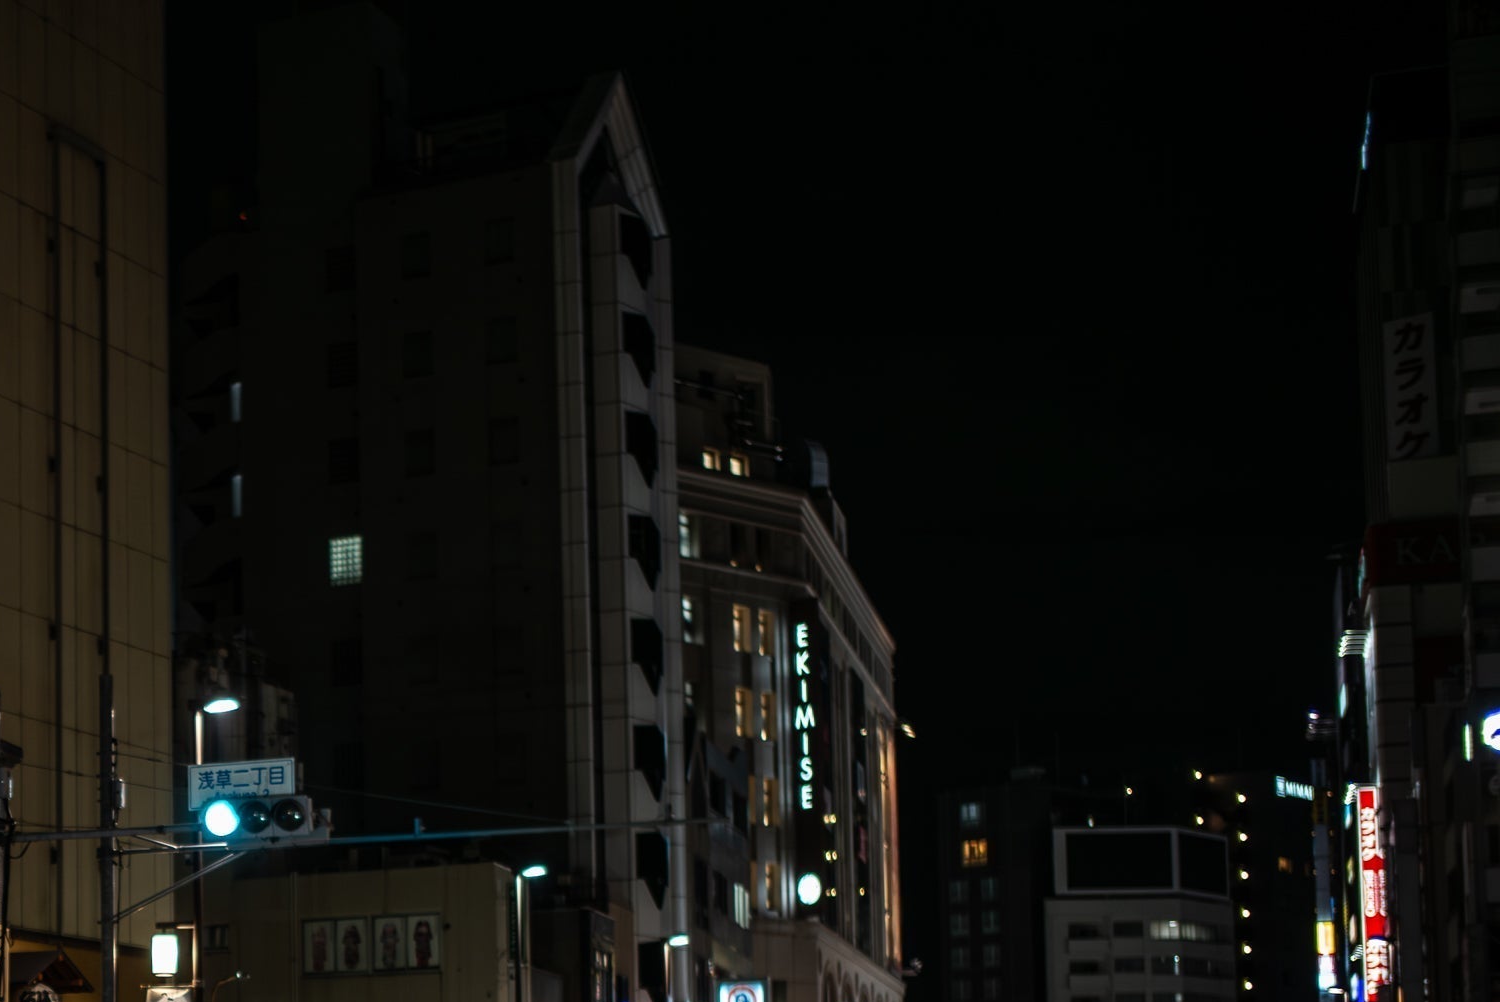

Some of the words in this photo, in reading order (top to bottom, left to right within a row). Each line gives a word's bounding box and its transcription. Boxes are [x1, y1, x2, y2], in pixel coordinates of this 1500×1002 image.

[1393, 322, 1429, 460] カラオケ
[197, 766, 285, 790] 浅草二丁目
[794, 622, 816, 810] EKIMISE
